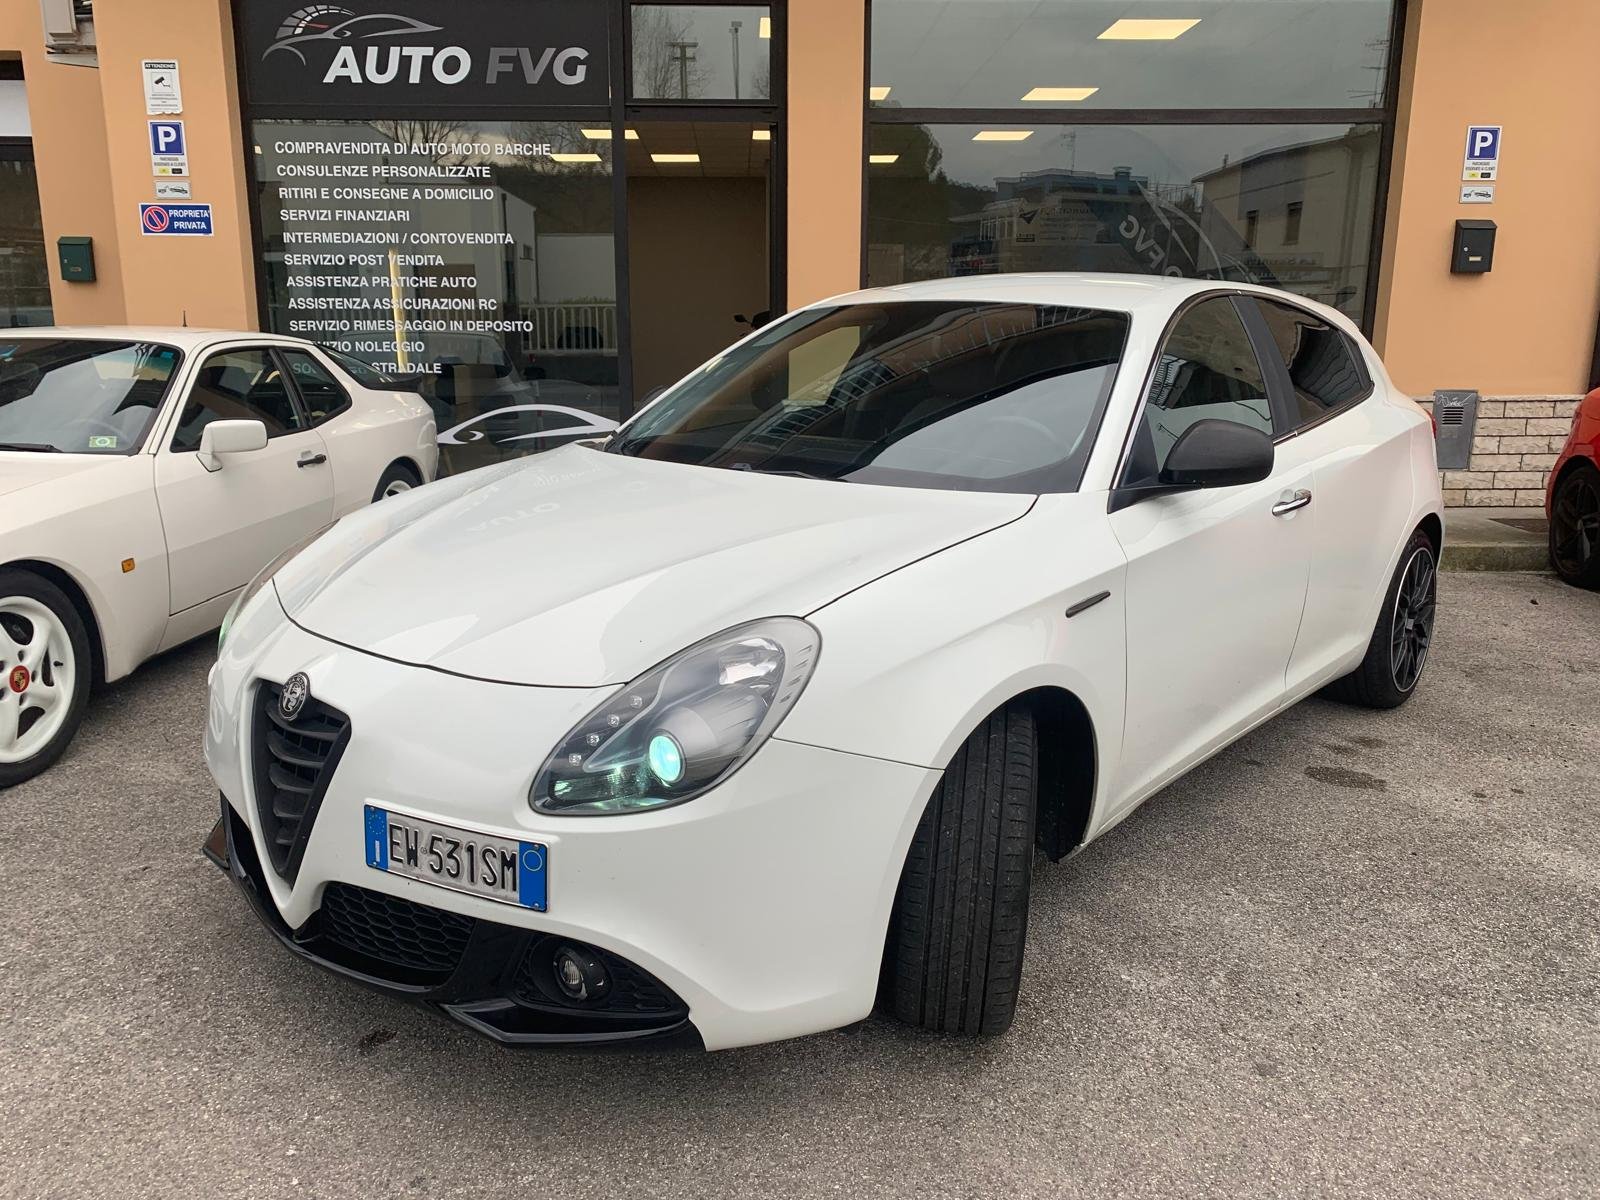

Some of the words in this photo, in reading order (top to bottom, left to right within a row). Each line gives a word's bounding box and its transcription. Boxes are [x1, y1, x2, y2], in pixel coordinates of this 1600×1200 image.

[322, 45, 472, 85] AUTO
[485, 46, 590, 85] FVG
[157, 125, 177, 151] P
[1473, 131, 1493, 156] P
[274, 141, 391, 154] COMPRAVENDITA
[394, 142, 407, 155] DI
[410, 142, 448, 155] AUTO
[451, 143, 491, 155] MOTO
[495, 143, 551, 156] BARCHE
[276, 165, 369, 177] CONSULENZE
[372, 165, 491, 178] PERSONALIZZATE
[278, 187, 317, 199] RITIRI
[321, 188, 330, 199] E
[333, 188, 409, 200] CONSEGNE
[412, 188, 421, 200] A
[424, 188, 494, 200] DOMICILIO
[280, 209, 332, 221] SERVIZI
[335, 210, 410, 221] FINANZIARI
[173, 221, 207, 230] PRIVATA
[282, 232, 400, 244] INTERMEDIAZIONI
[410, 233, 515, 244] CONTOVENDITA
[284, 254, 345, 266] SERVIZIO
[348, 254, 385, 266] POST
[388, 254, 445, 266] VENDITA
[286, 276, 369, 288] ASSISTENZA
[372, 276, 438, 288] PRATICHE
[440, 276, 477, 288] AUTO
[288, 298, 371, 309] ASSISTENZA
[373, 298, 475, 310] ASSICURAZIONI
[478, 299, 498, 310] RC
[289, 320, 350, 332] SERVIZIO
[353, 320, 447, 332] RIMESSAGGIO
[450, 320, 463, 331] IN
[466, 321, 534, 332] DEPOSITO
[355, 341, 425, 352] NOLEGGIO
[371, 362, 442, 374] STRADALE
[389, 822, 419, 868] EW
[428, 833, 518, 892] 531SM
